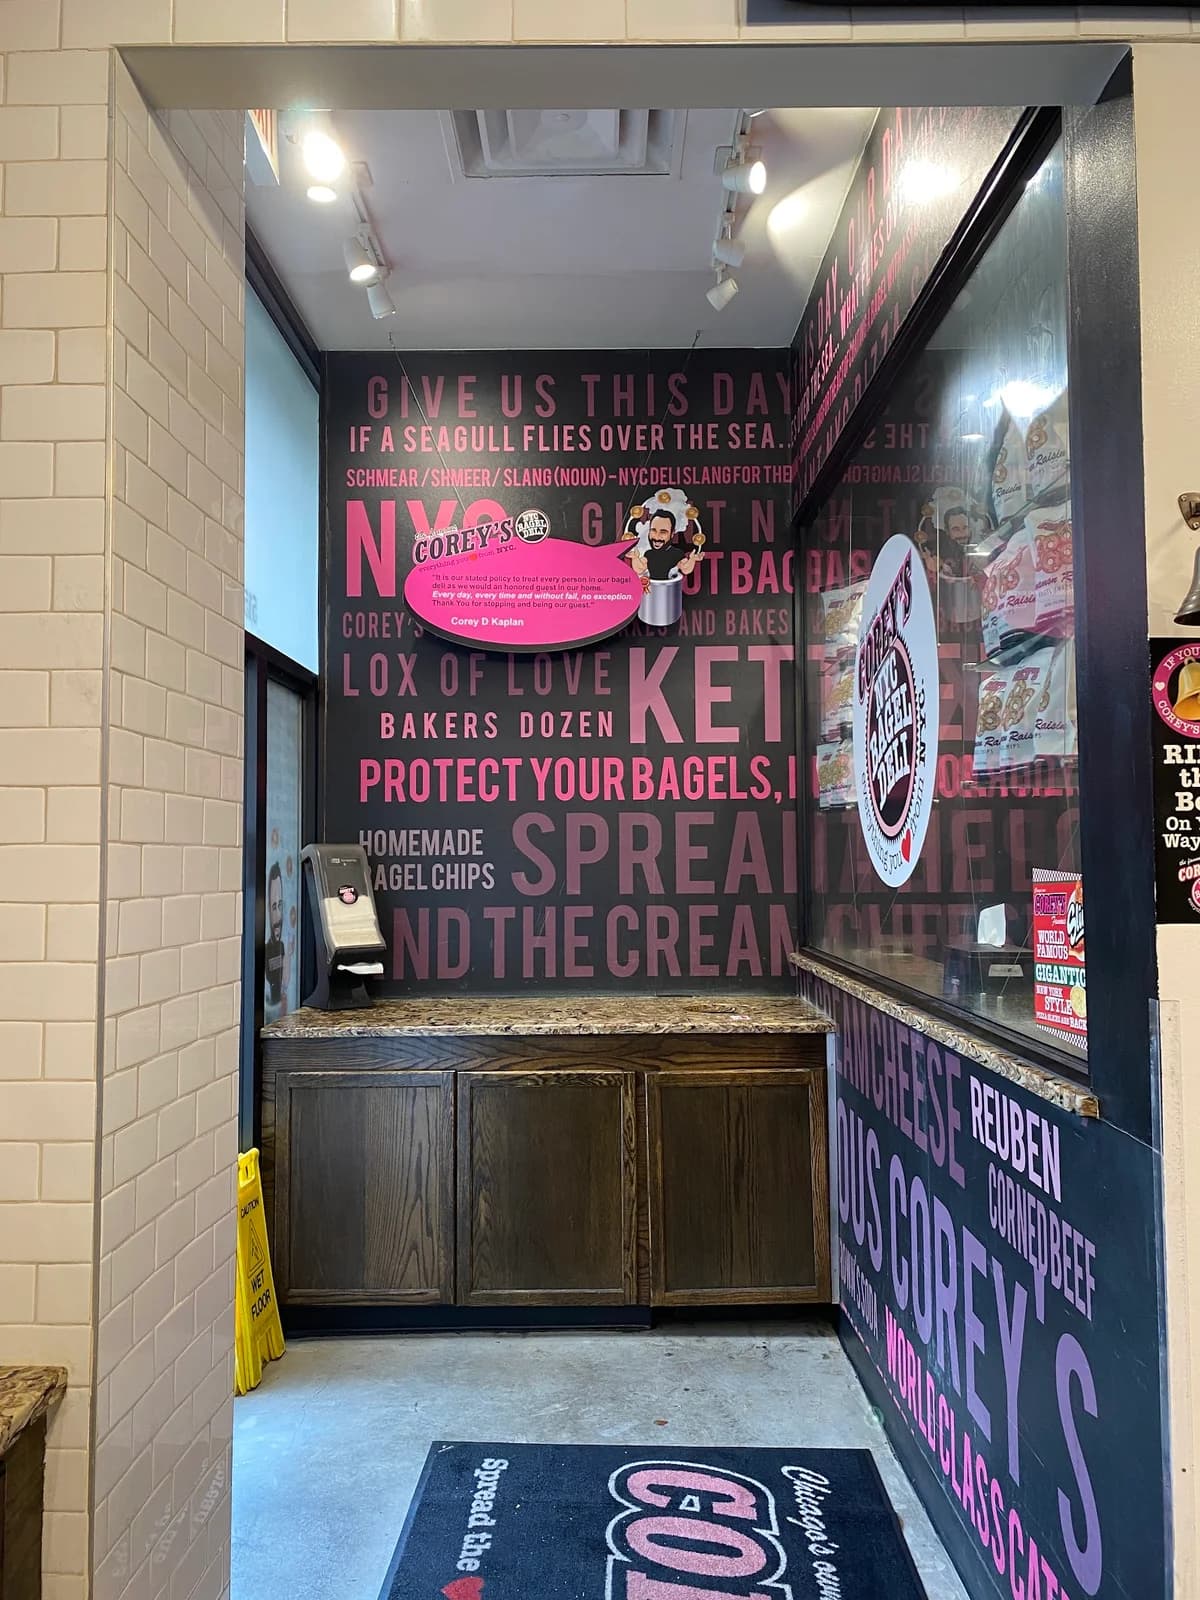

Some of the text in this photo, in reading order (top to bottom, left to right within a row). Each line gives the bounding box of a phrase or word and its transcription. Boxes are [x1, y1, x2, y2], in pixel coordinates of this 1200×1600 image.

[367, 375, 478, 418] GIVE
[501, 374, 556, 417] US
[581, 372, 688, 416] THIS
[350, 426, 371, 453] IF
[380, 425, 394, 453] A
[404, 424, 515, 452] SEAGULL
[523, 424, 592, 452] FLIES
[600, 423, 664, 450] OVER
[673, 423, 719, 450] THE
[517, 519, 547, 532] BAGEL
[523, 527, 544, 538] DELI
[413, 517, 513, 564] COREY'S
[489, 575, 511, 583] policy
[432, 590, 455, 600] Every
[456, 591, 473, 600] day,
[475, 592, 497, 600] every
[534, 592, 564, 600] without
[565, 592, 579, 601] fail,
[484, 600, 516, 608] stopping
[450, 616, 524, 628] Corey D Kaplan
[679, 609, 715, 636] AND
[726, 609, 788, 635] BAKES
[858, 548, 913, 705] COREY'S
[1163, 646, 1200, 671] IF YOU
[343, 652, 612, 697] LOX OF LOVE
[873, 648, 898, 715] NYC
[380, 711, 613, 739] BAKERS DOZEN
[869, 681, 914, 781] BAGEL
[1158, 700, 1200, 735] COREY'S
[360, 758, 522, 803] PROTECT
[530, 756, 624, 801] YOUR
[632, 755, 783, 804] BAGELS,
[878, 731, 911, 811] DELI
[1165, 816, 1192, 831] On
[359, 829, 483, 857] HOMEMADE
[368, 862, 495, 890] AGEL CHIPS
[390, 907, 471, 981] ND
[483, 906, 594, 978] THE
[1037, 930, 1065, 944] WORLD
[1036, 944, 1069, 960] FAMOUS
[1035, 963, 1086, 988] GIGANTIC
[1044, 996, 1073, 1016] STYLE
[969, 1074, 1062, 1203] REUBEN
[240, 1196, 260, 1218] CAUTION
[251, 1269, 265, 1294] WET
[251, 1289, 272, 1321] FLOOR
[889, 1154, 1103, 1596] COREY'S
[884, 1303, 1005, 1575] WORLD CLASS
[456, 1458, 509, 1571] Spread the
[781, 1465, 840, 1556] Chicago's
